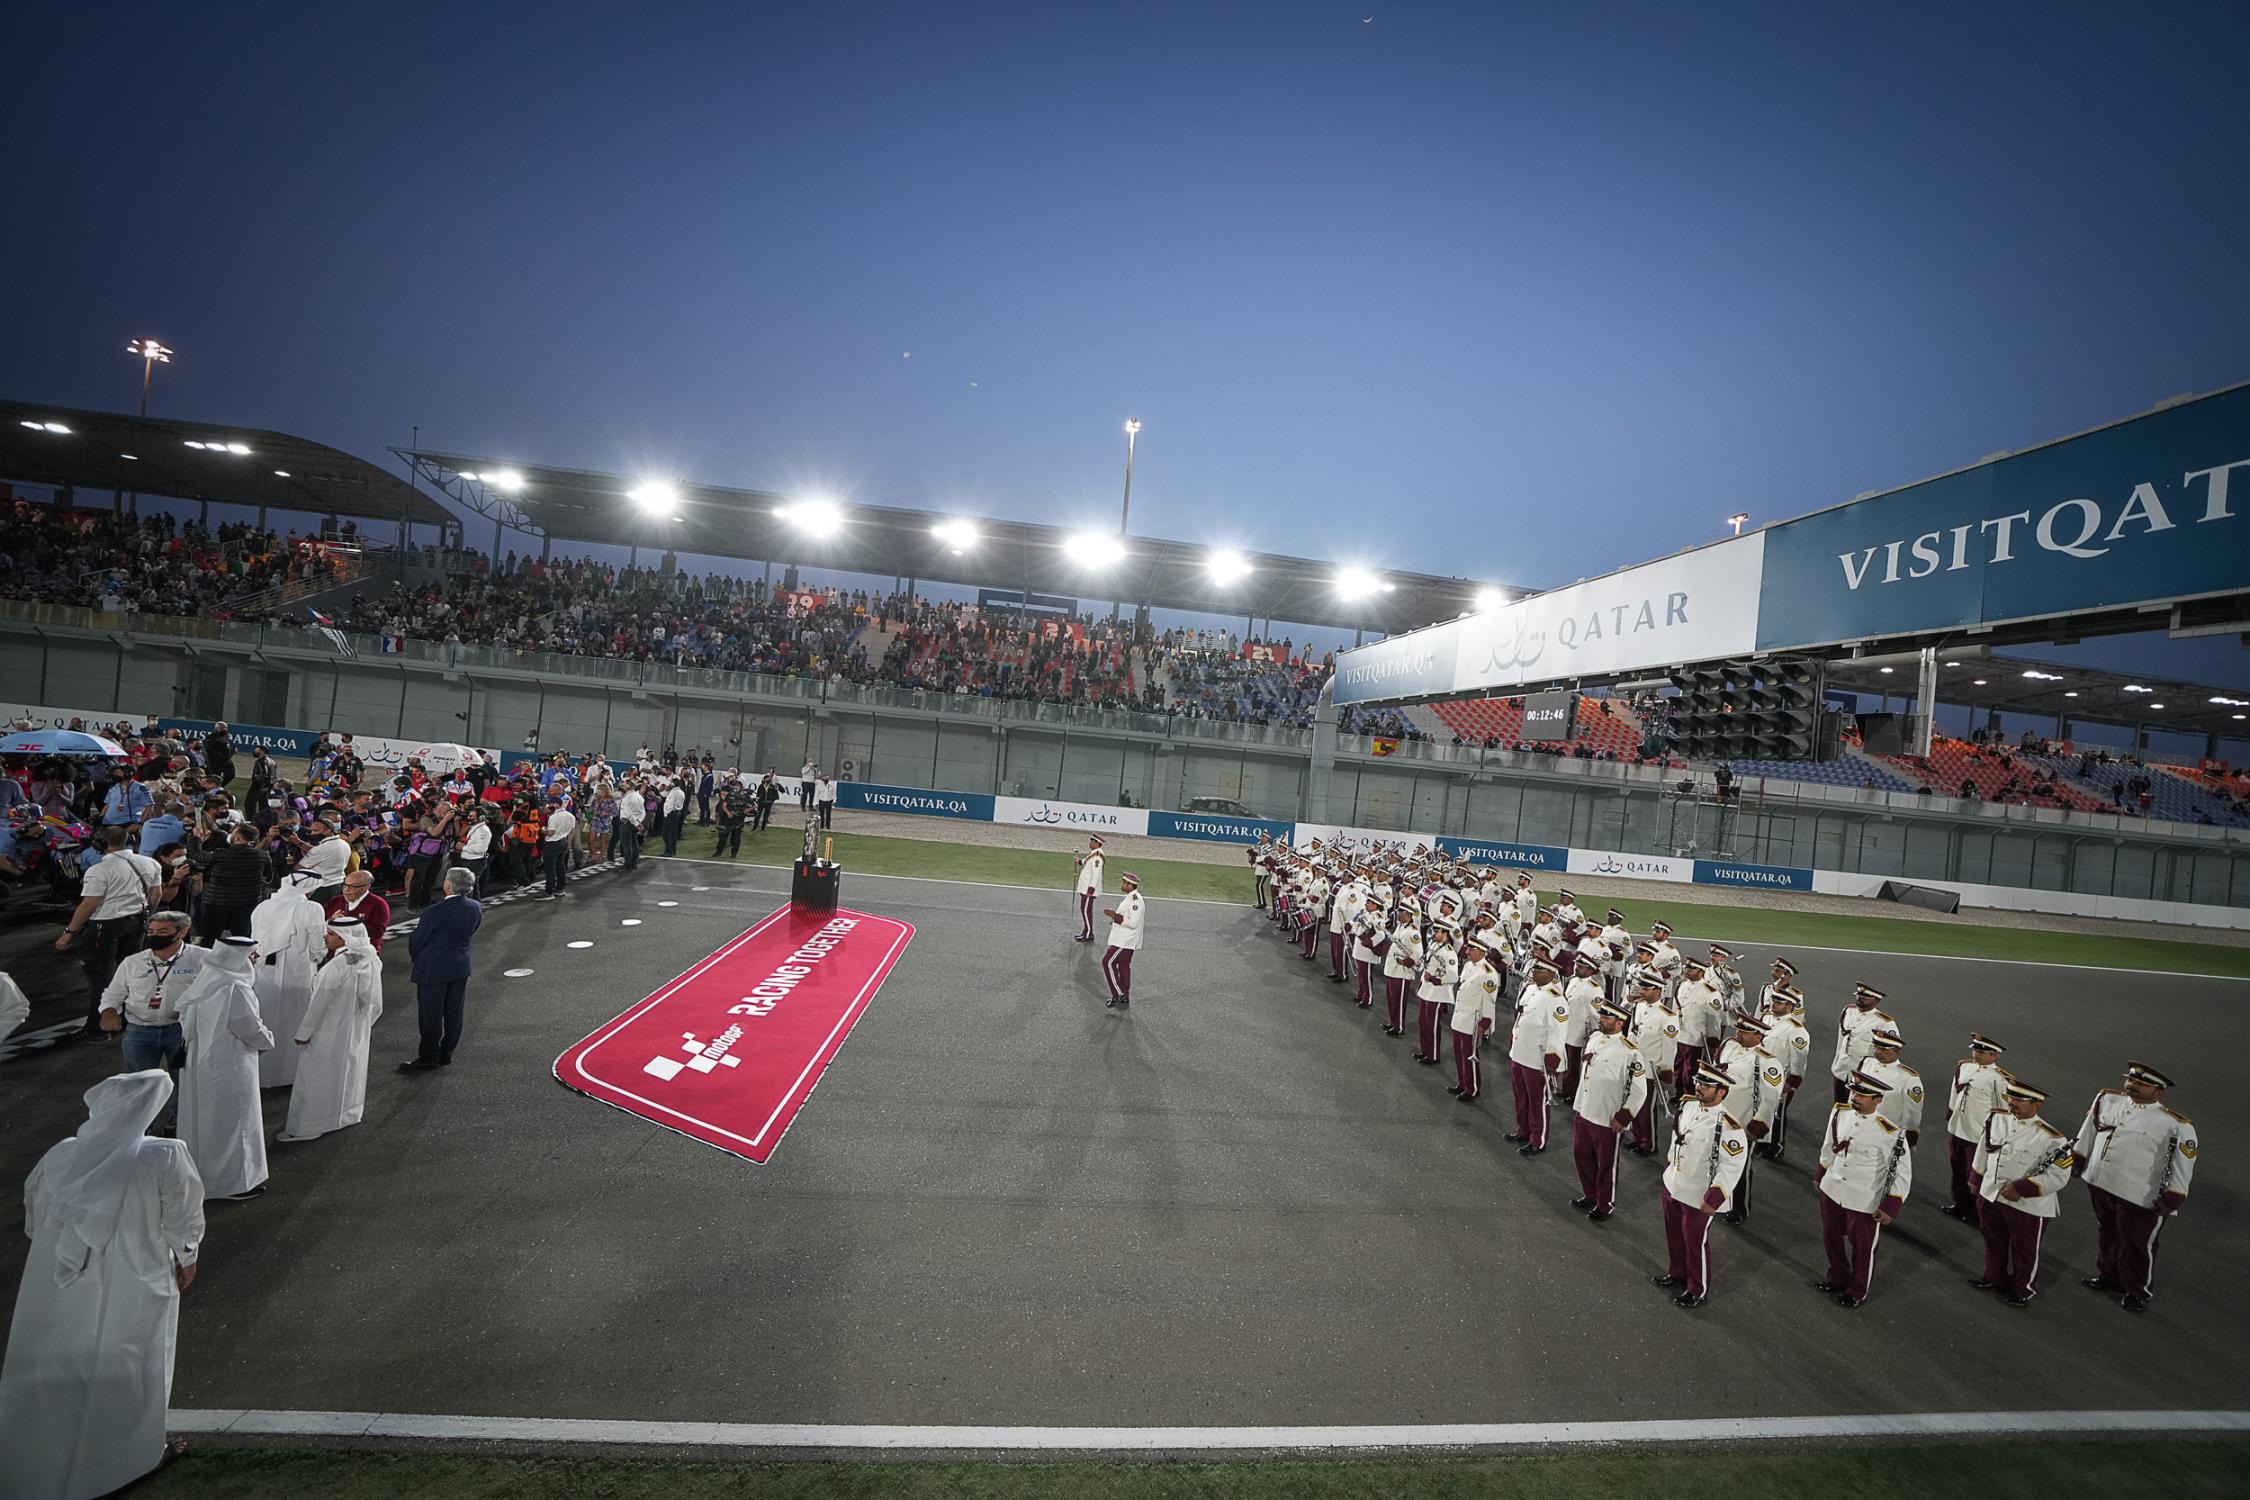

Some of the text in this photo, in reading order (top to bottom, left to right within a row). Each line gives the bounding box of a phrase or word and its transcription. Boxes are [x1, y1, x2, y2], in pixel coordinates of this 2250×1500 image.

[1839, 459, 2250, 591] VISITQAT
[1558, 592, 1689, 650] QATAR
[1346, 651, 1433, 685] VISITQATAR.QA
[1527, 709, 1564, 720] 00:12:46
[864, 793, 967, 812] VISITQATAR.QA
[1067, 812, 1117, 824] QATAR
[1627, 862, 1669, 873] QATAR
[1714, 869, 1792, 885] VISITQATAR.QA
[727, 918, 860, 1016] RACING TOGETHER
